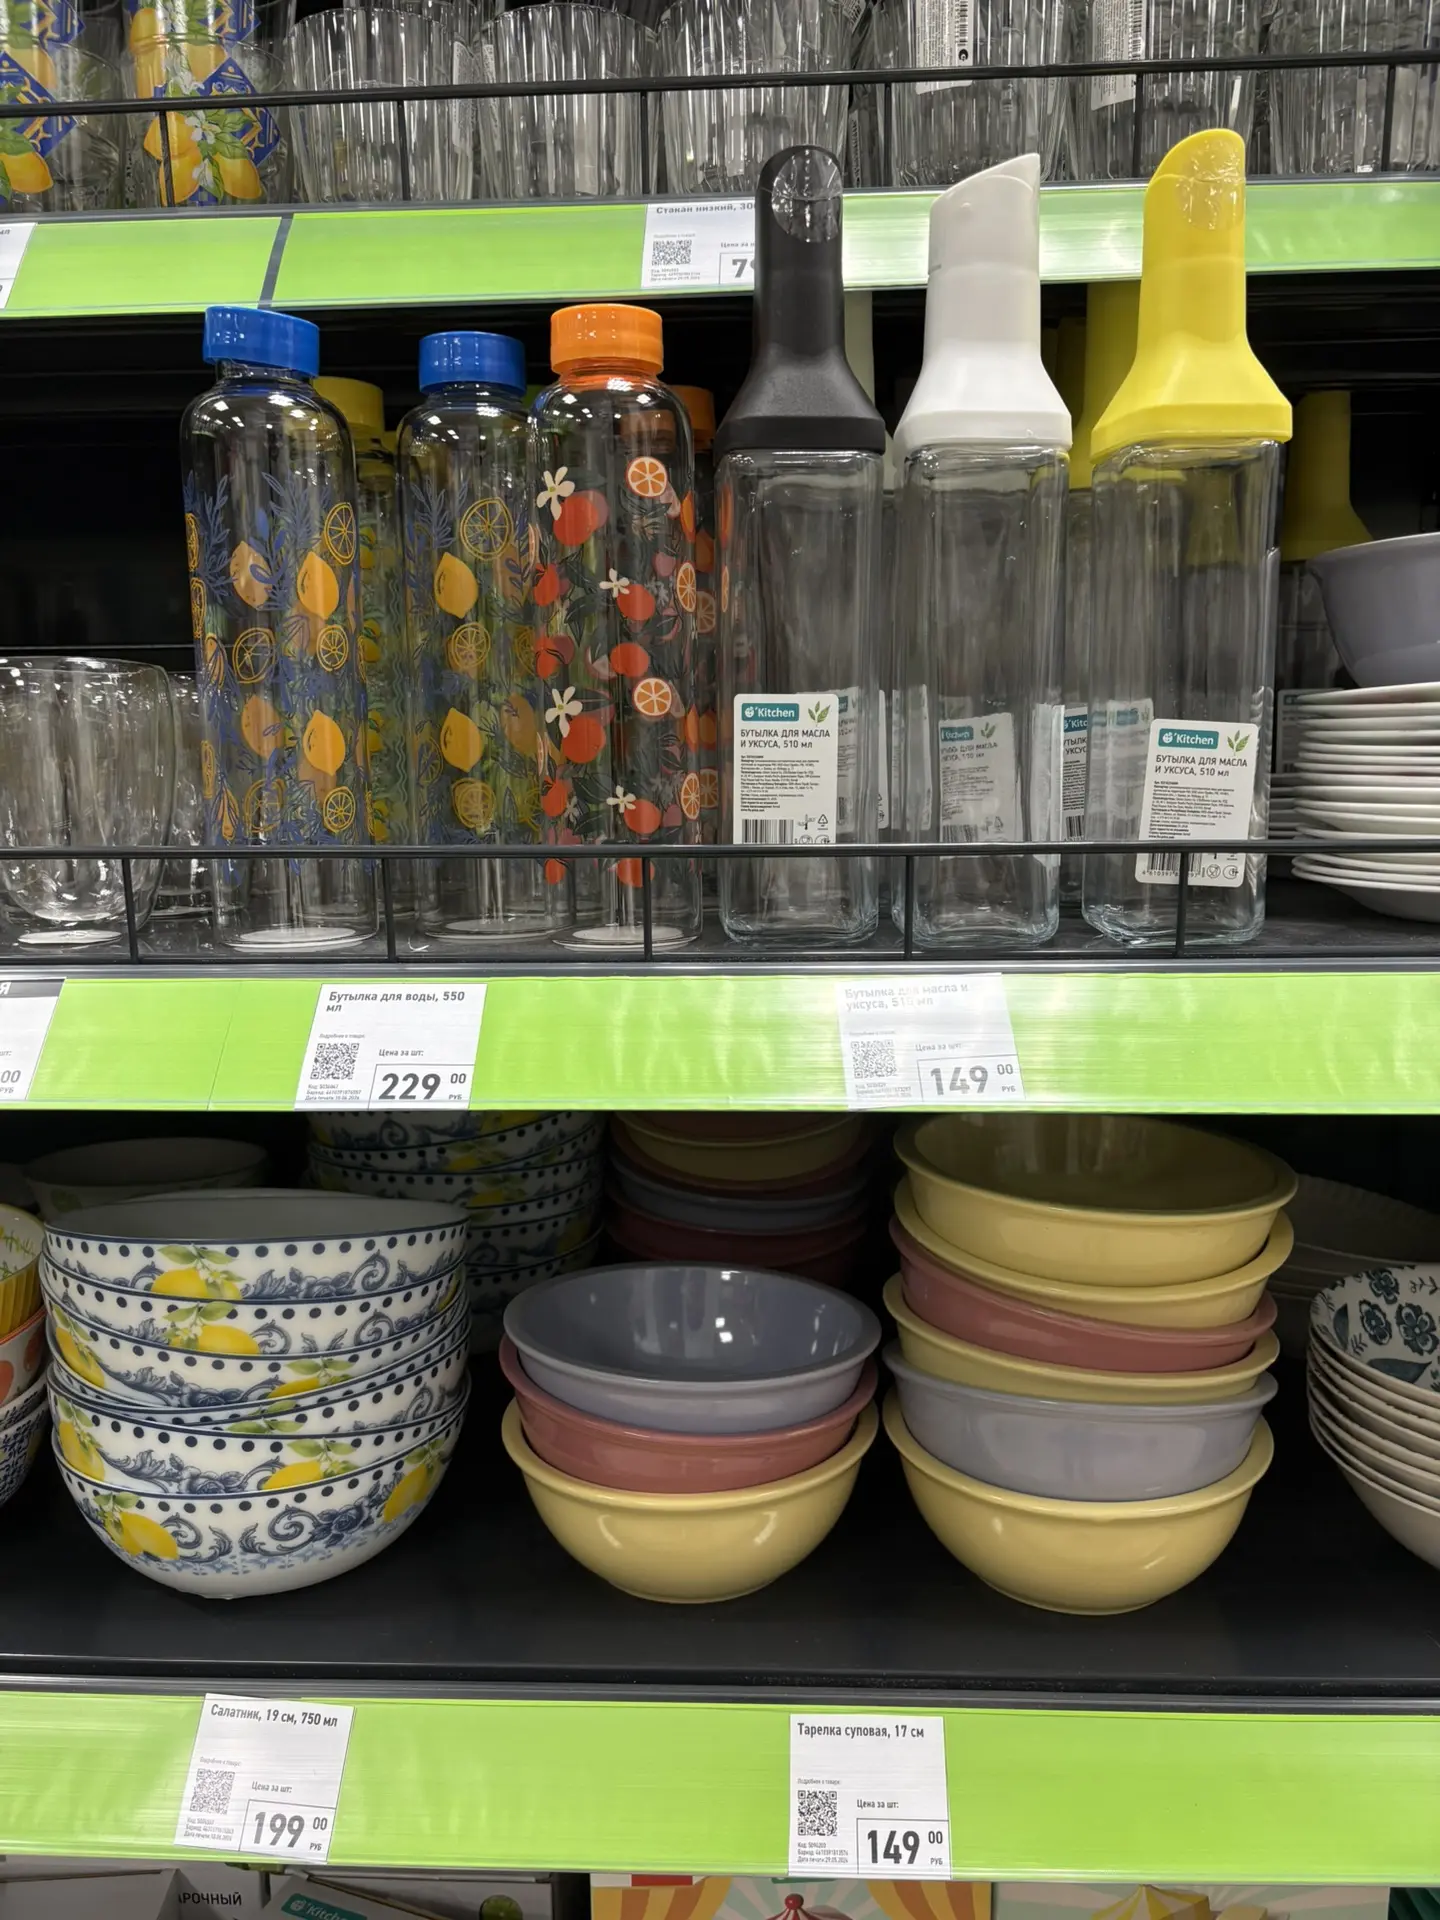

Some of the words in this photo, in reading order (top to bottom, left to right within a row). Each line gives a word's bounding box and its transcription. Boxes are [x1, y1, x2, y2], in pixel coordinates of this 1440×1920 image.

[656, 206, 693, 214] Стакан
[696, 204, 737, 212] низкий,
[740, 202, 756, 210] 30
[740, 729, 779, 738] БУТЫЛКА
[781, 730, 799, 738] ДЛЯ
[801, 730, 831, 738] МАСЛА
[740, 740, 747, 748] И
[748, 740, 781, 749] УКСУСА,
[783, 740, 799, 748] 510
[1156, 754, 1196, 765] БУТЫЛКА
[1198, 757, 1217, 766] ДЛЯ
[1219, 758, 1248, 767] МАСЛА
[1155, 766, 1162, 774] И
[1163, 766, 1197, 776] УКСУСА,
[1199, 768, 1215, 776] 510
[329, 991, 377, 1003] Бутылка
[380, 992, 402, 1002] для
[405, 991, 438, 1002] воды,
[443, 991, 465, 1001] 550
[845, 988, 895, 999] Бутылка
[923, 983, 958, 994] масла
[961, 983, 969, 992] и
[326, 1004, 342, 1012] мл
[846, 1000, 889, 1011] уксуса,
[379, 1048, 399, 1057] Цена
[915, 1042, 936, 1052] Цена
[938, 1043, 947, 1051] за
[996, 1063, 1014, 1075] 00
[450, 1073, 467, 1084] 00
[930, 1065, 989, 1096] 149
[378, 1073, 441, 1100] 229
[1001, 1085, 1016, 1093] РУБ
[210, 1703, 262, 1722] Салатник,
[266, 1708, 280, 1722] 19
[281, 1713, 298, 1725] см,
[301, 1711, 322, 1726] 750
[323, 1716, 338, 1727] мл
[797, 1722, 842, 1738] Тарелка
[844, 1726, 891, 1739] суповая,
[895, 1724, 908, 1738] 17
[911, 1727, 924, 1738] см
[252, 1780, 270, 1793] Цена
[271, 1785, 280, 1793] за
[280, 1785, 293, 1794] шт:
[857, 1799, 876, 1809] Цена
[877, 1801, 886, 1809] за
[887, 1801, 900, 1809] шт:
[253, 1811, 305, 1848] 199
[312, 1816, 328, 1831] 00
[928, 1830, 944, 1845] 00
[309, 1842, 323, 1851] РУБ
[867, 1829, 920, 1865] 149
[930, 1857, 944, 1866] РУБ
